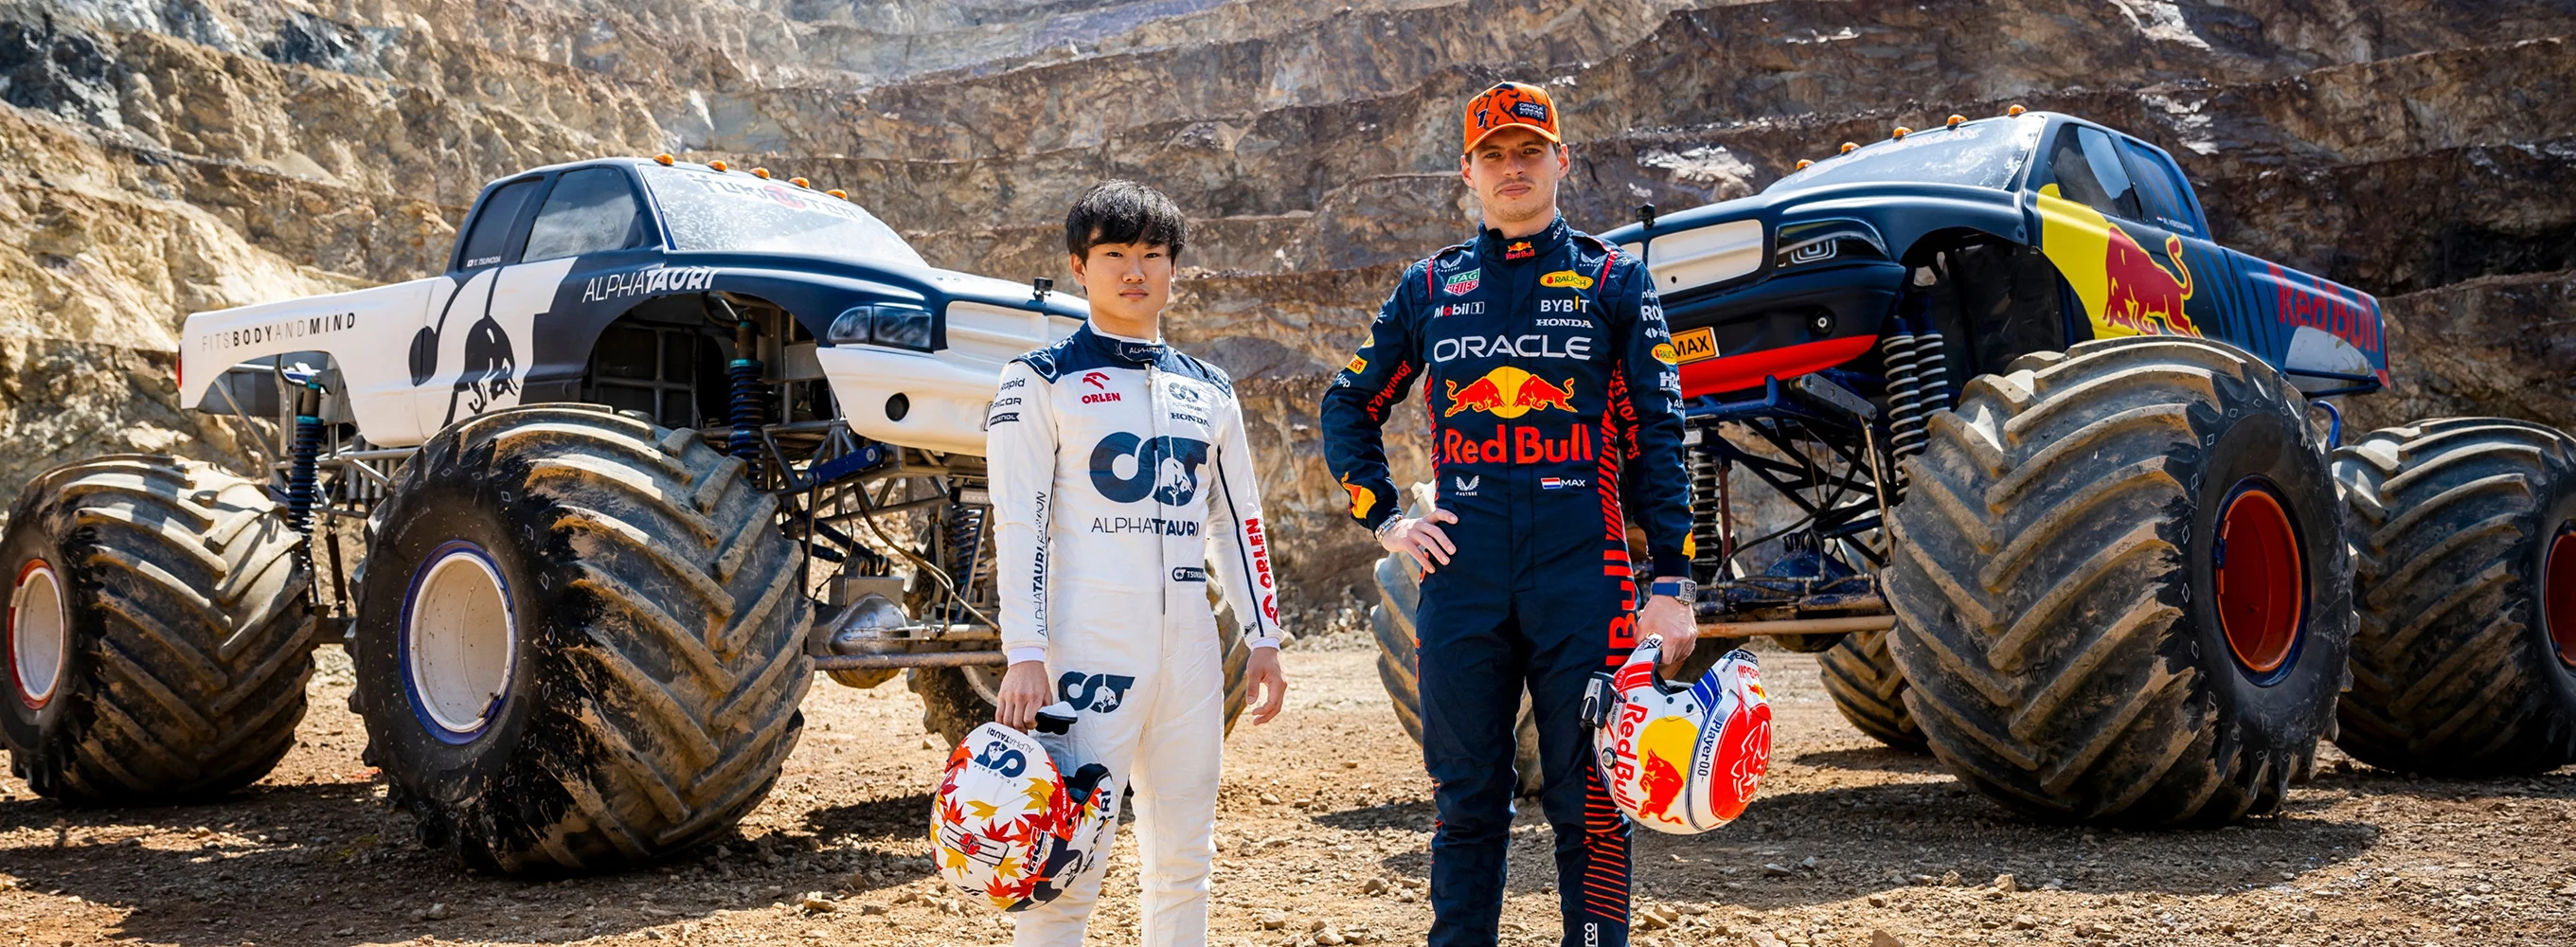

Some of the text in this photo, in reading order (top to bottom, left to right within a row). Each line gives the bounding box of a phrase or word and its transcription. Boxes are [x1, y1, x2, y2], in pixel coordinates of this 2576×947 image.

[1505, 249, 1534, 260] Red Bull
[582, 266, 721, 303] ALPHATAURI
[1452, 271, 1477, 283] TAG
[1554, 275, 1587, 287] RAUCH
[1446, 280, 1478, 295] HEUER
[1434, 303, 1469, 318] Mobil
[1540, 295, 1590, 313] BYBIT
[1535, 318, 1593, 329] HONDA
[1433, 334, 1592, 363] ORACLE
[1673, 335, 1710, 357] MAX
[992, 397, 1022, 409] PICOR
[1082, 392, 1121, 404] ORLEN
[1171, 412, 1211, 427] HONDA
[1441, 423, 1593, 464] Red Bull
[1561, 478, 1586, 488] MAX
[1091, 517, 1199, 537] ALPHATAURI
[1244, 517, 1273, 589] ORLEN
[1603, 549, 1638, 649] Bull
[986, 727, 1034, 754] ALPHATAURI
[1702, 720, 1724, 761] Player
[1613, 704, 1648, 811] Red Bull
